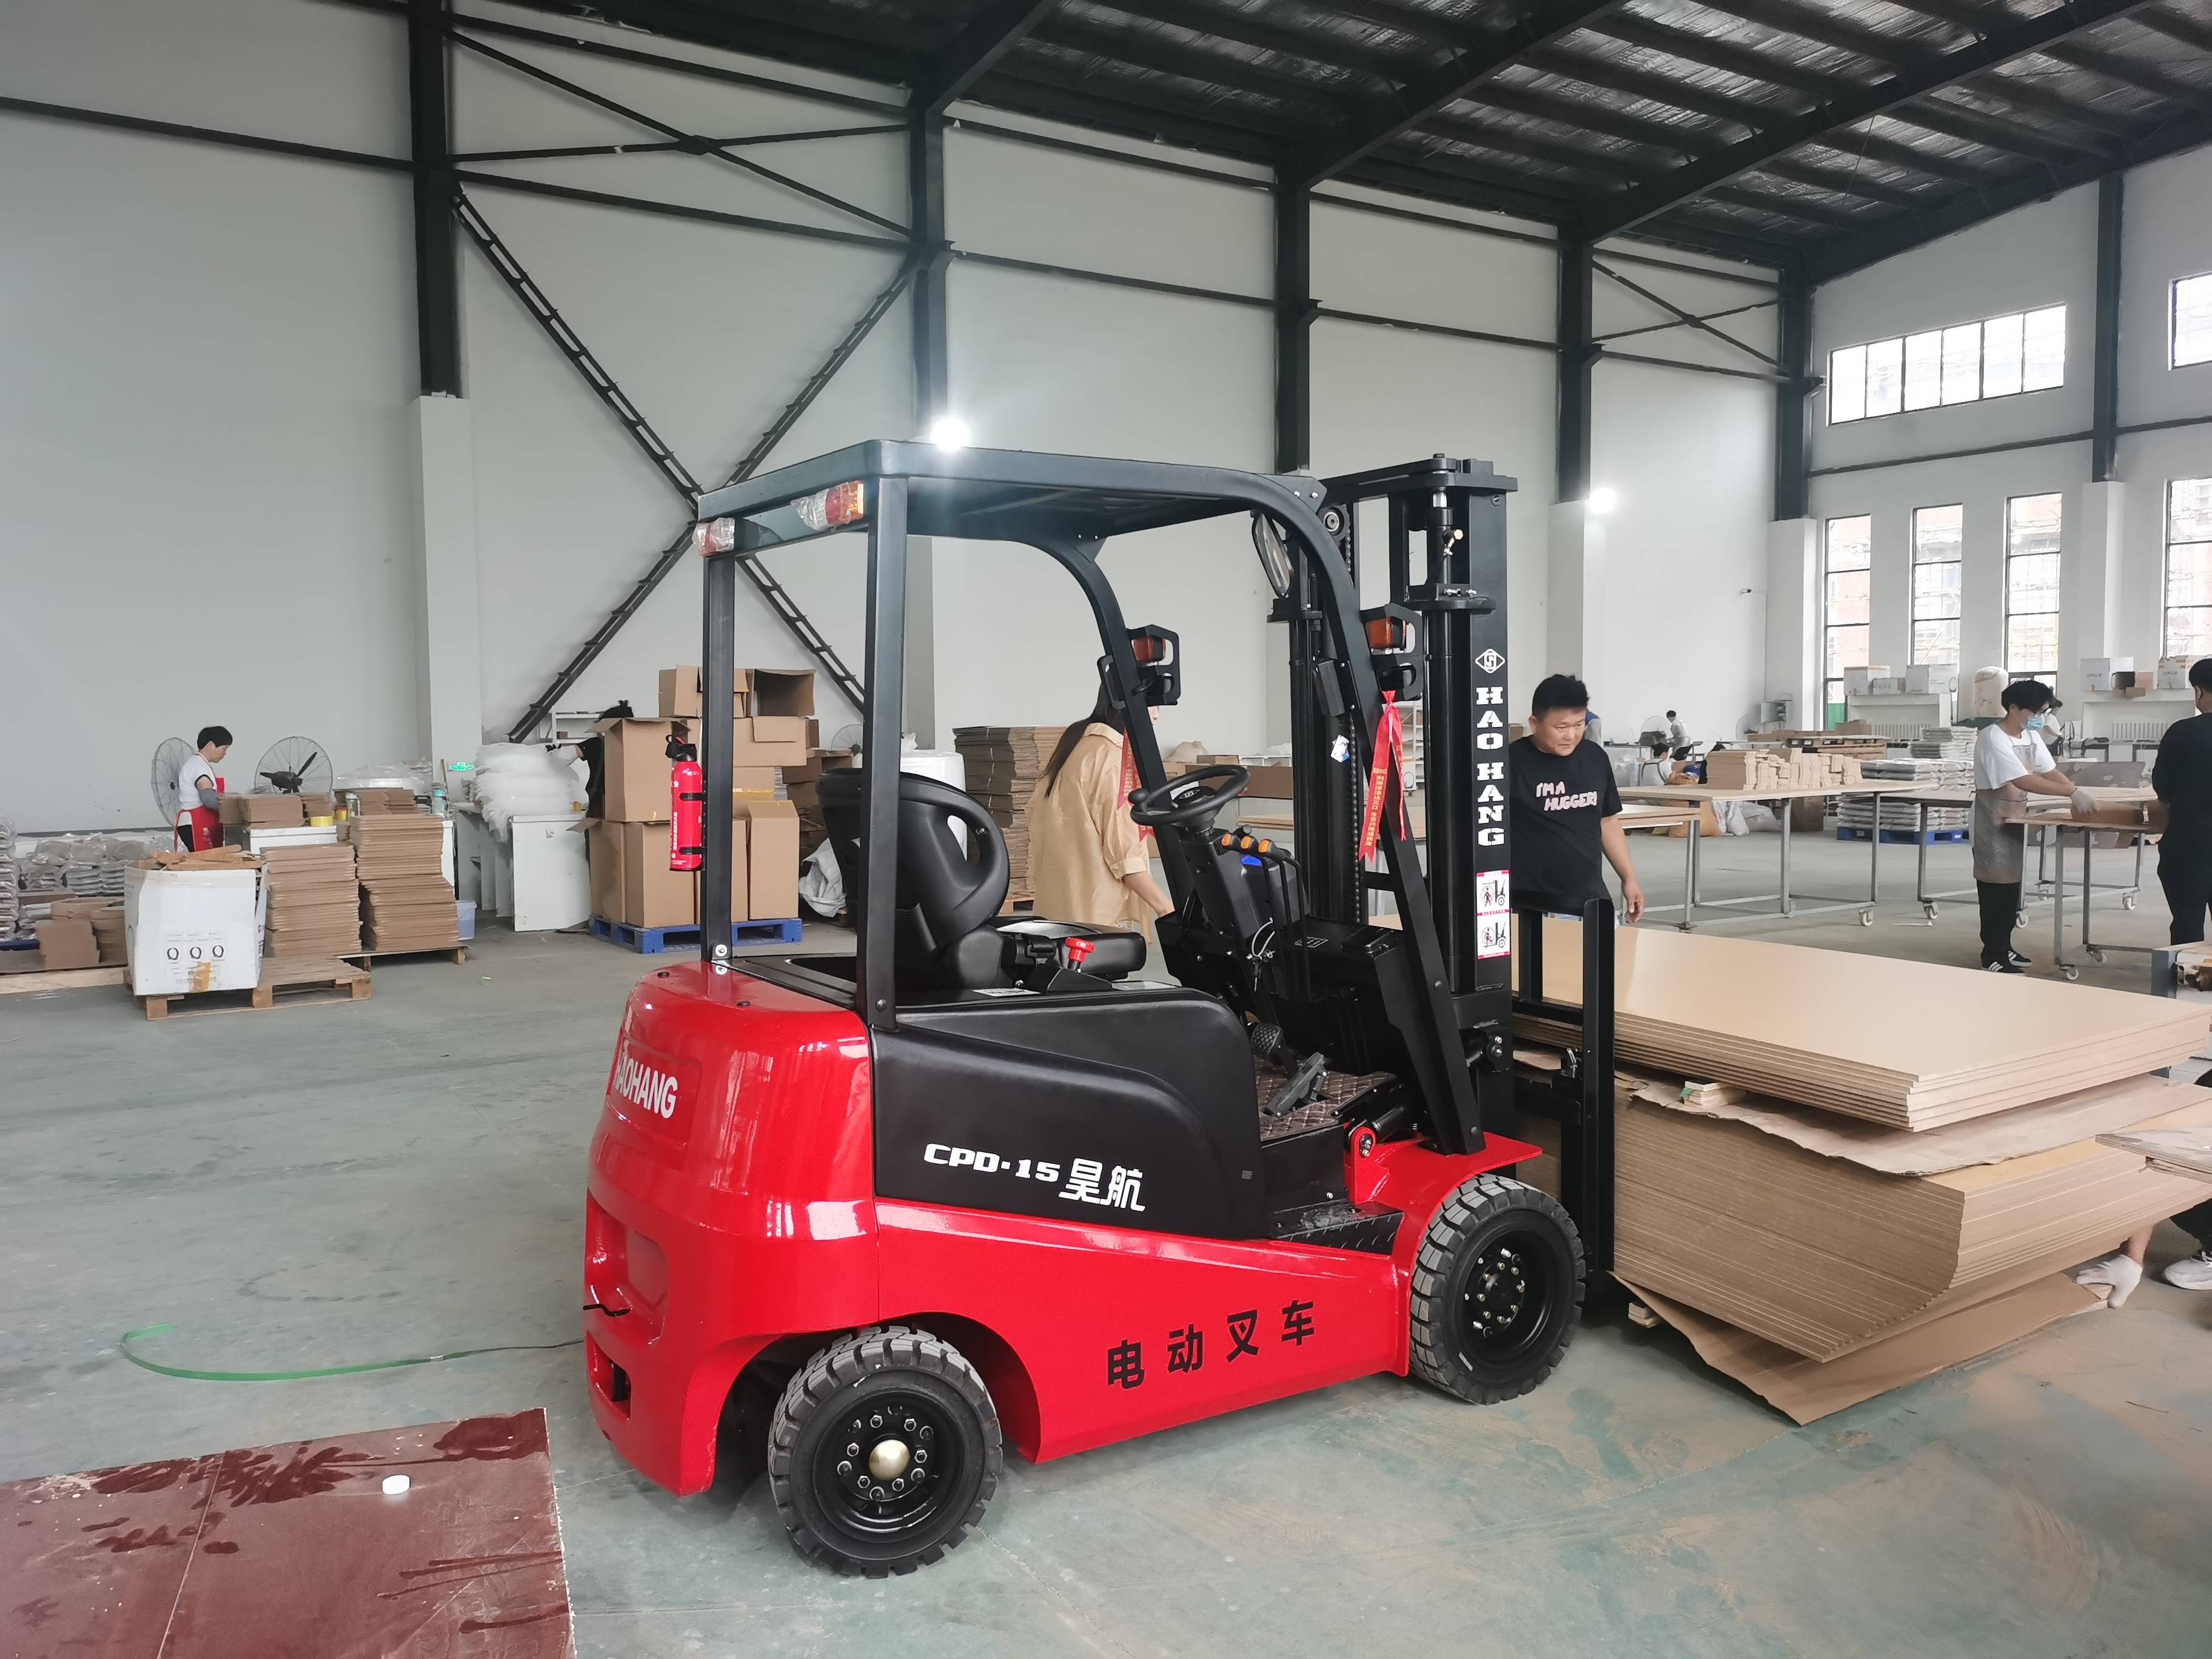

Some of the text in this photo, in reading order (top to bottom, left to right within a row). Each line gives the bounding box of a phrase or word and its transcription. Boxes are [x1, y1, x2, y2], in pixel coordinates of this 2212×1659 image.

[1476, 686, 1503, 750] HAO
[1477, 762, 1504, 846] HANG
[1544, 791, 1597, 811] HUGGER!
[1555, 781, 1565, 795] A
[1107, 1299, 1315, 1390] 电动叉车
